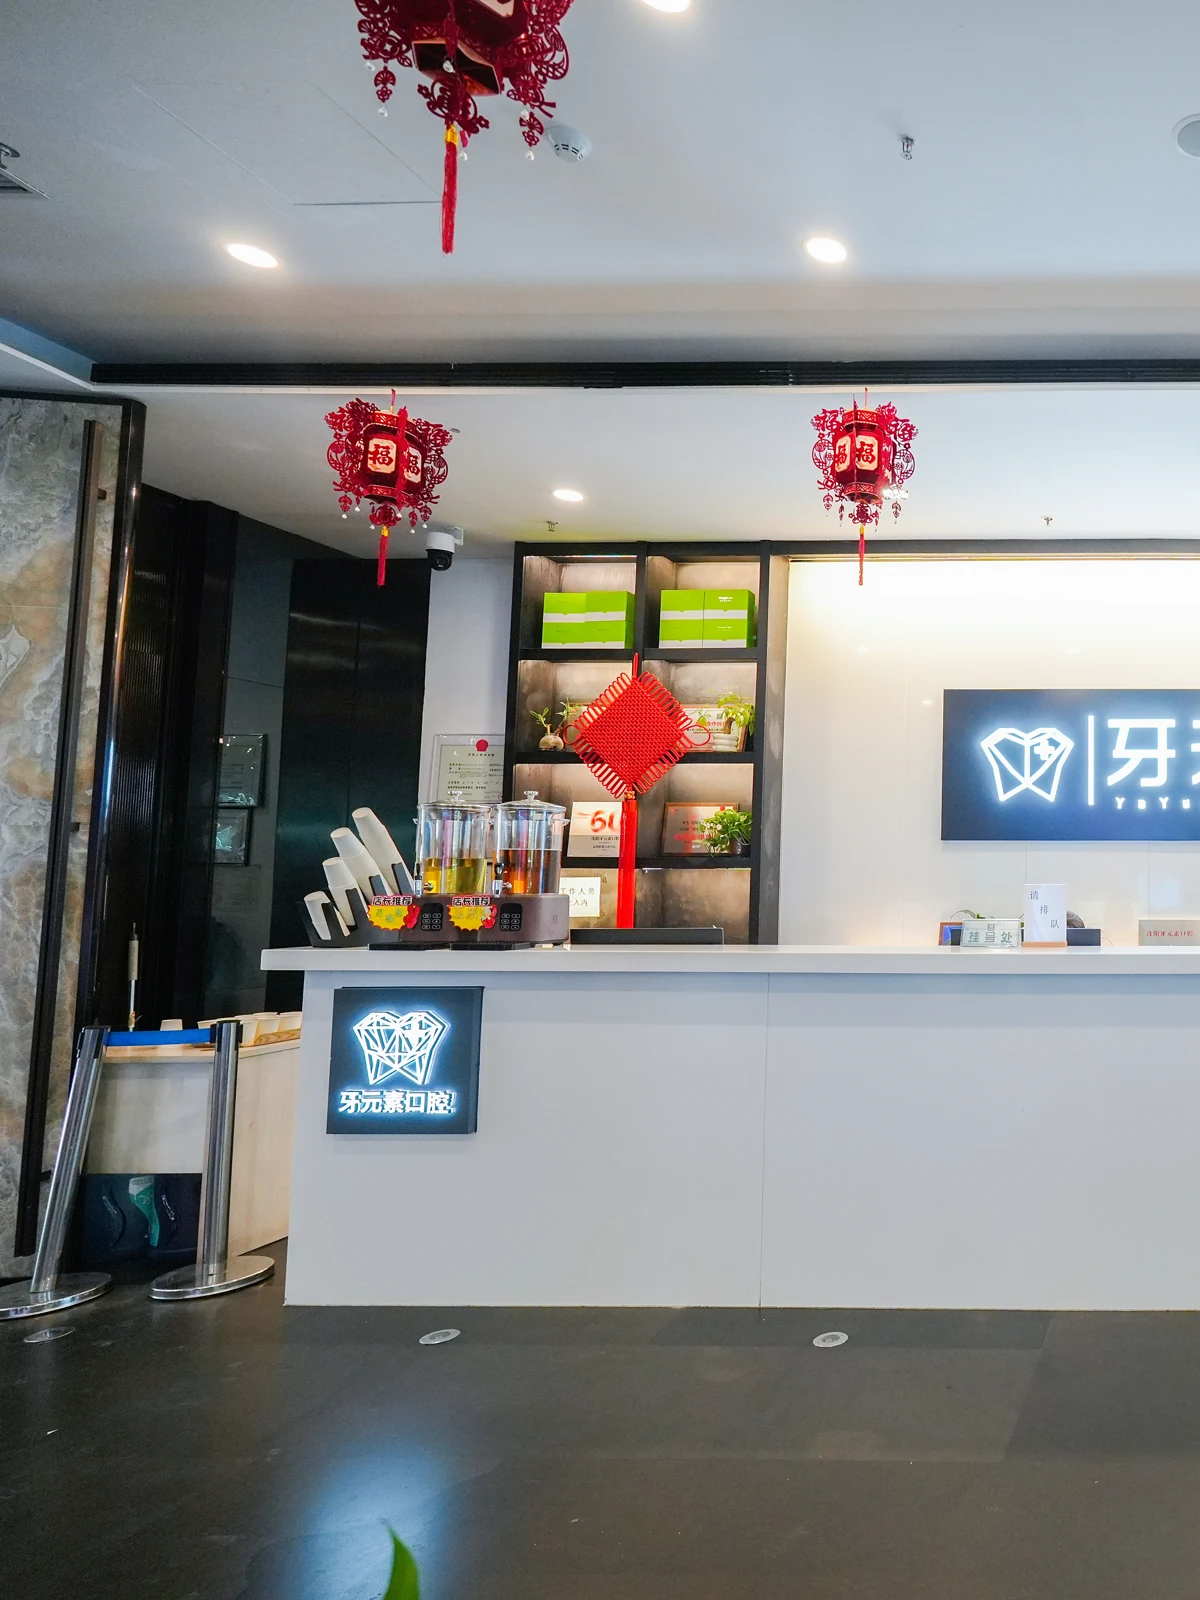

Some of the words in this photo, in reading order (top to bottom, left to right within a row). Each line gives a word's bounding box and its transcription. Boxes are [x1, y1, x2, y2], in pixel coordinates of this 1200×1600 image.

[368, 444, 393, 466] 福
[856, 441, 876, 463] 福
[373, 896, 412, 906] 店长推荐
[452, 896, 490, 906] 店长推荐
[968, 931, 1013, 943] 挂号处
[338, 1090, 456, 1114] 牙元素口腔
